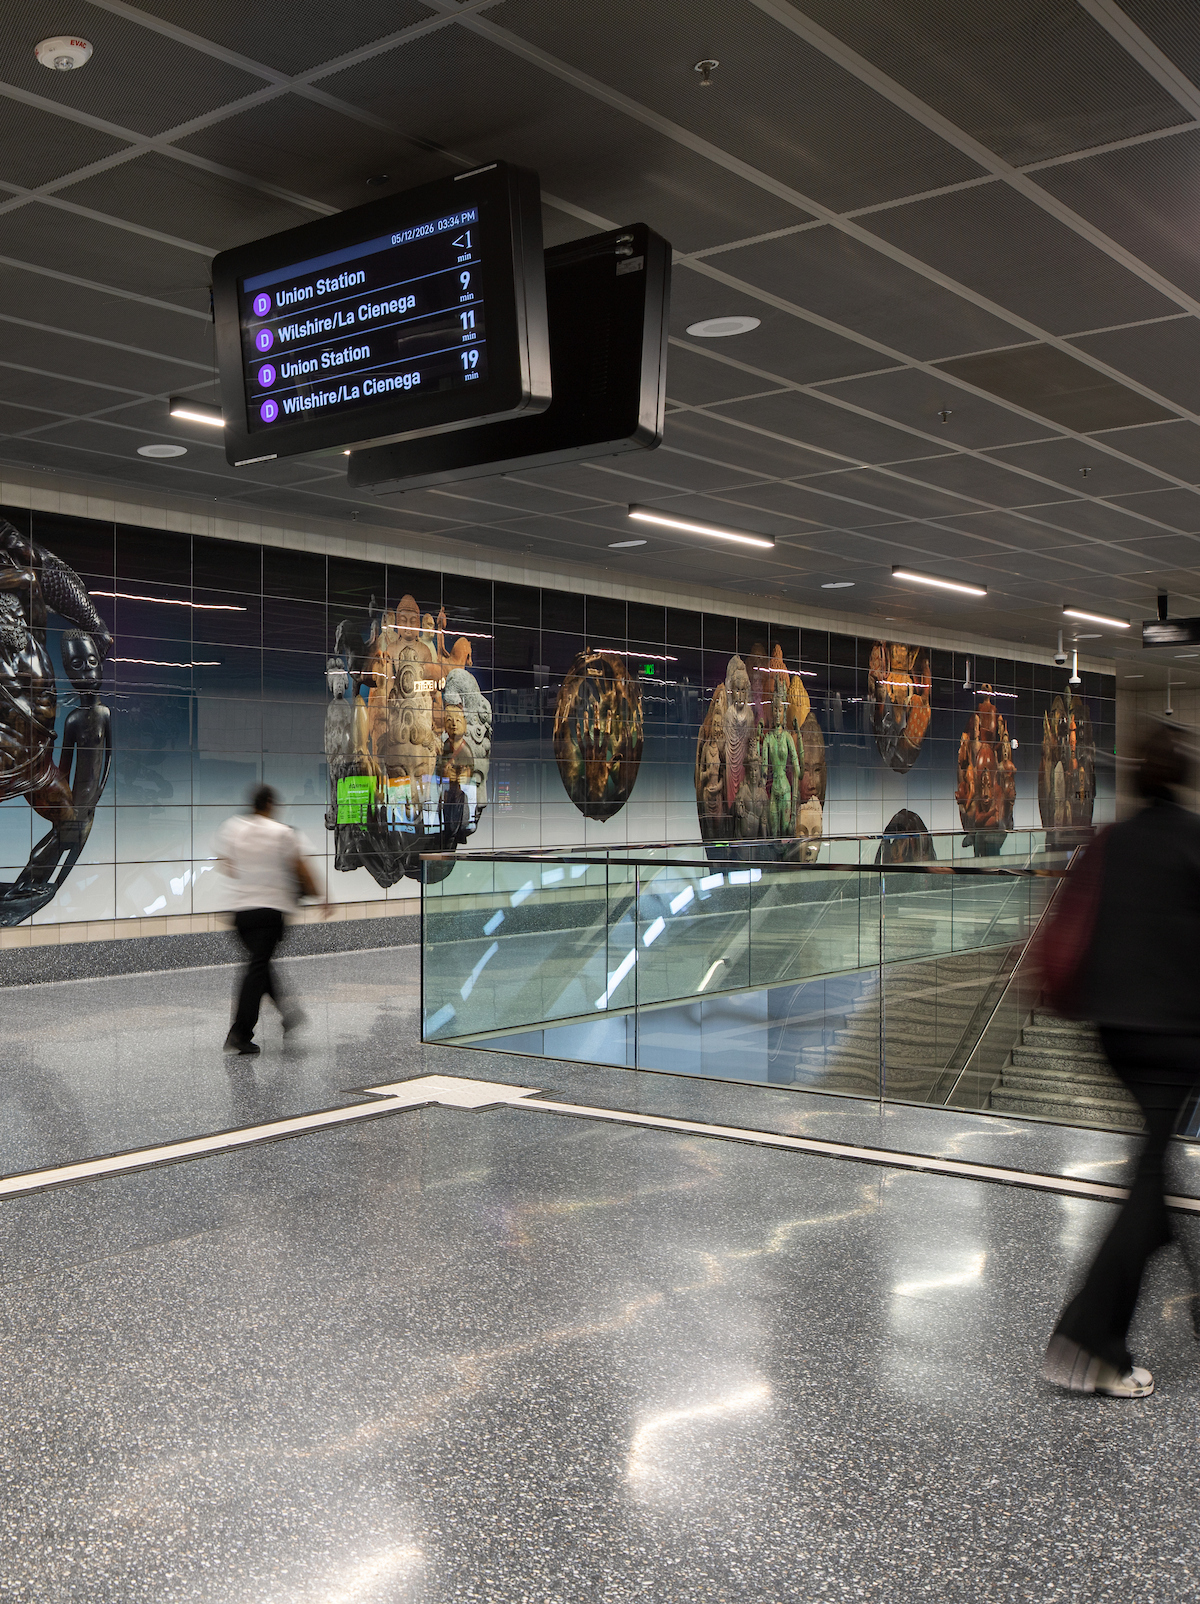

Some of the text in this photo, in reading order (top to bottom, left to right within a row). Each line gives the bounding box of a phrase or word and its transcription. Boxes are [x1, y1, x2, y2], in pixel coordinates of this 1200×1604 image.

[70, 39, 87, 49] EVAC
[391, 210, 476, 245] 05/12/2026 03:34 PM
[457, 251, 472, 263] min
[258, 270, 366, 313] D Union Station
[460, 271, 471, 291] 9
[460, 291, 475, 303] min
[260, 294, 416, 348] D Wilshire/La Cienega
[460, 309, 476, 331] 11
[462, 331, 477, 342] min
[262, 345, 371, 384] D Union Station
[461, 349, 480, 371] 19
[464, 370, 480, 382] min
[265, 371, 422, 419] D Wilshire/La Cienega
